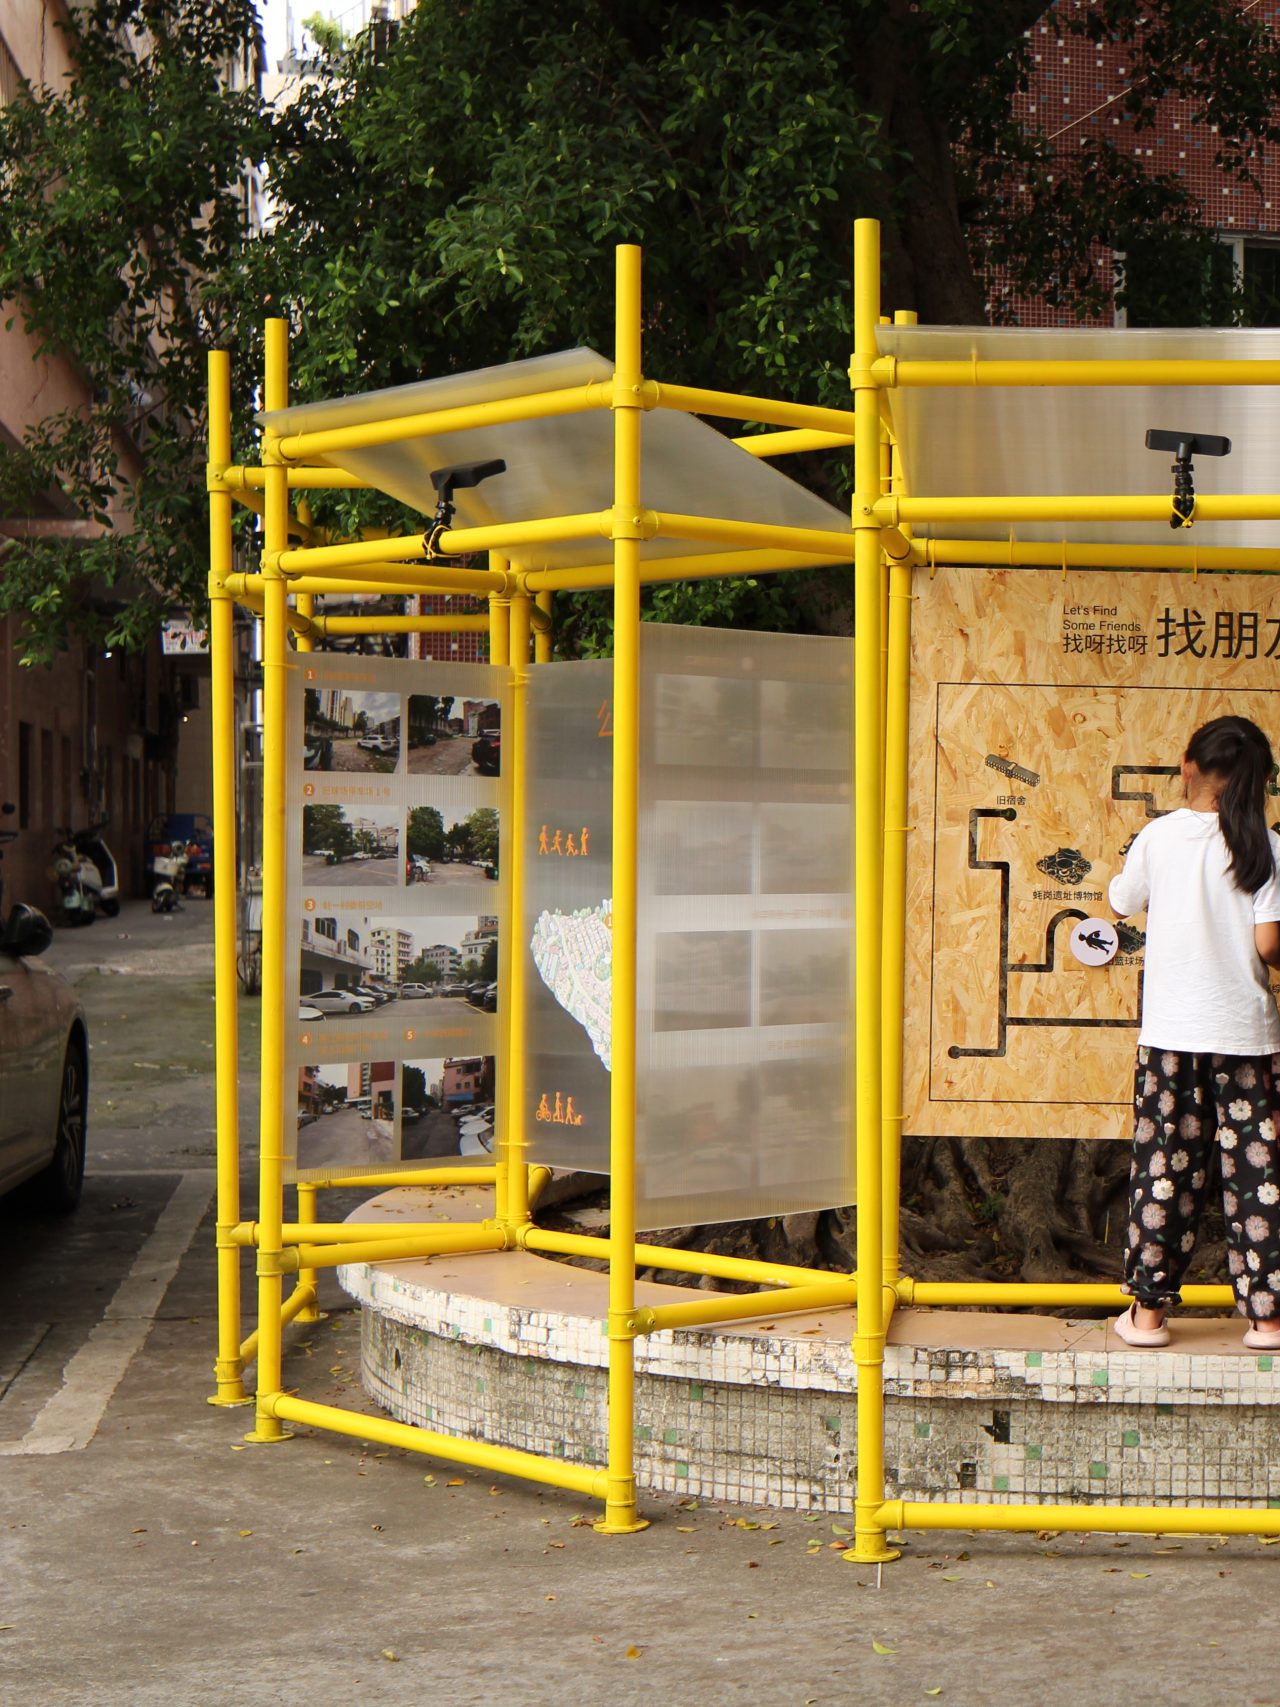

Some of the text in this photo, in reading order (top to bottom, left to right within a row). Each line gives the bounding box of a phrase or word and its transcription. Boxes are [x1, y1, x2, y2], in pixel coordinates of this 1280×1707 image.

[1063, 605, 1118, 616] Let's Find
[1063, 620, 1141, 632] Some Friends
[1062, 633, 1148, 656] 找呀找呀
[996, 795, 1027, 806] 旧宿舍
